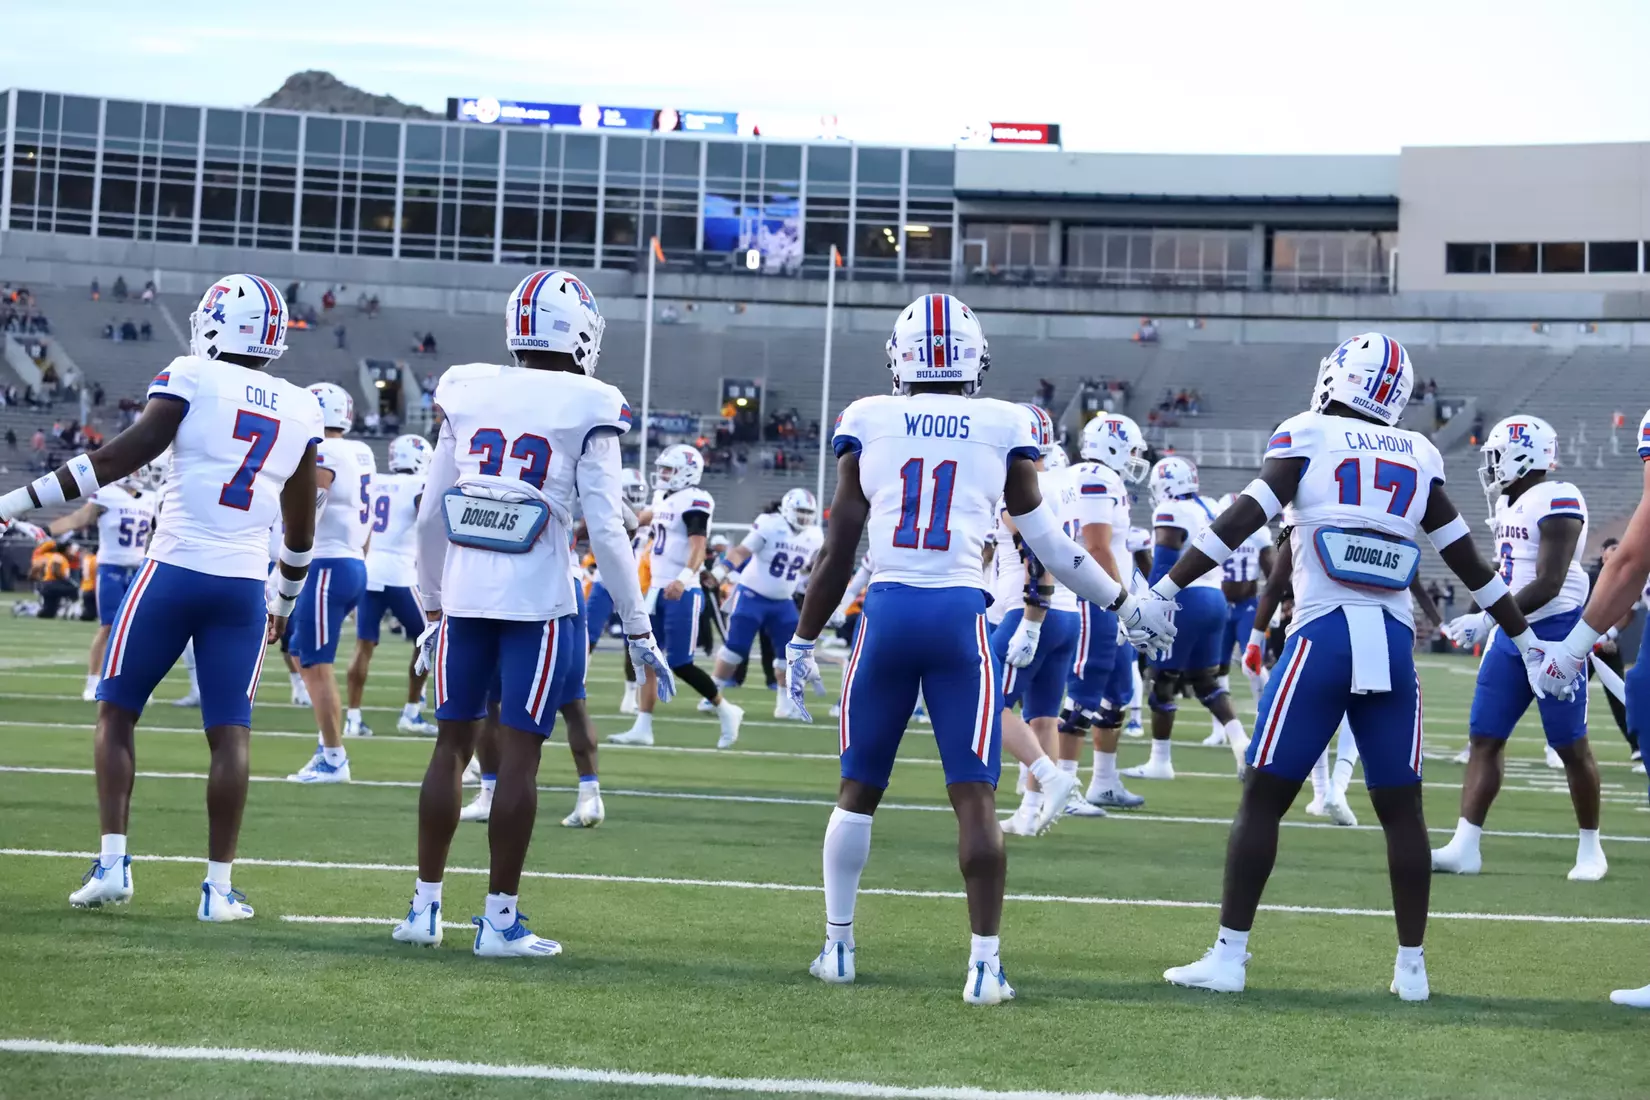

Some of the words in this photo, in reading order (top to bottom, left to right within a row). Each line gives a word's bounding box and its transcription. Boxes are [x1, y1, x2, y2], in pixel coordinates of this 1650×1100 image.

[510, 338, 549, 348] BULLDOGS
[916, 370, 963, 378] BULLDOGS
[246, 385, 278, 411] COLE
[1352, 396, 1392, 420] BULLDOGS
[904, 412, 971, 439] WOODS
[1345, 431, 1414, 455] CALHOUN
[219, 408, 281, 511] 7
[1334, 457, 1417, 518] 17
[892, 457, 957, 551] 11
[118, 517, 150, 547] 52
[461, 507, 519, 531] DOUGLAS
[769, 551, 804, 581] 62
[1222, 556, 1248, 582] 51
[1344, 545, 1400, 570] DOUGLAS
